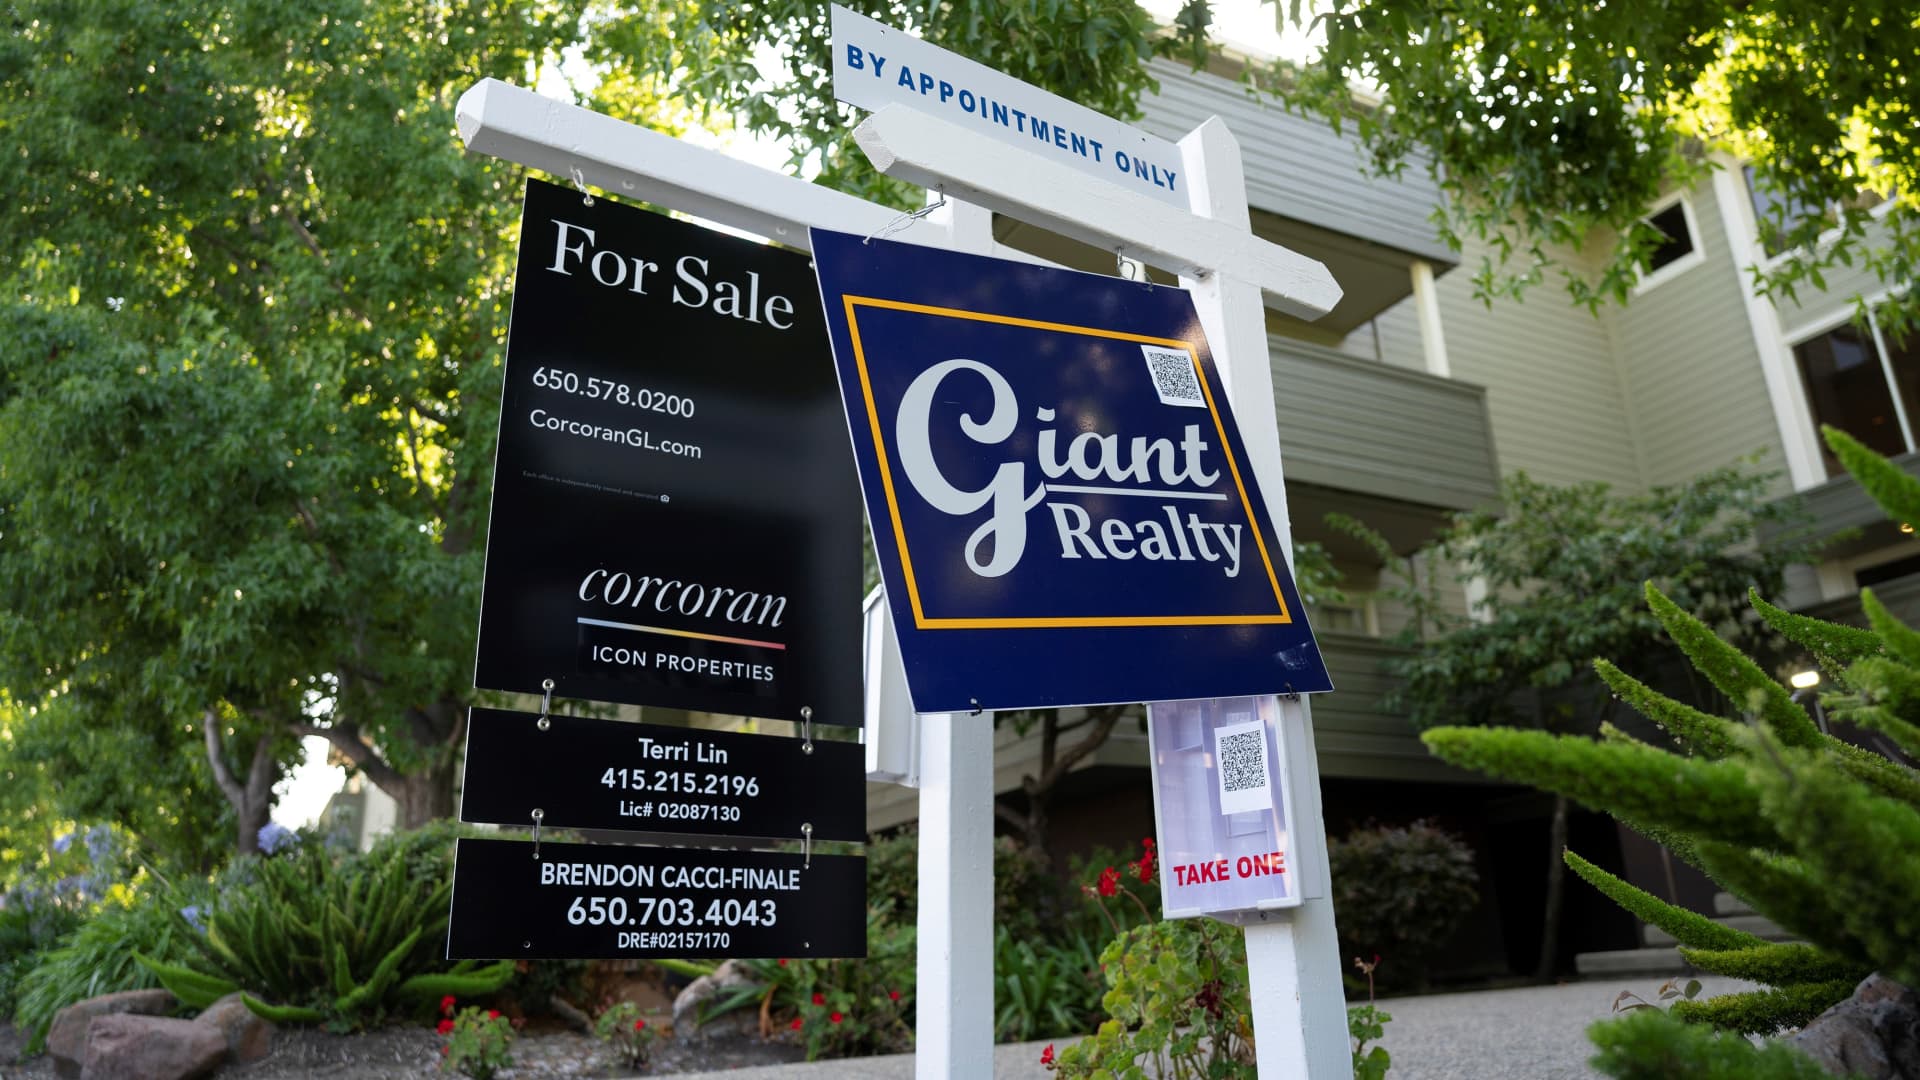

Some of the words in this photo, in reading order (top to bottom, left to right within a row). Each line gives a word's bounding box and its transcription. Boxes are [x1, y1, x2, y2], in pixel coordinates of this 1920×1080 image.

[847, 44, 886, 77] BY
[898, 66, 1102, 161] APPOINTMENT
[1115, 151, 1176, 191] ONLY
[546, 220, 658, 294] For
[673, 256, 793, 329] Sale
[533, 367, 694, 418] 650.578.0200
[530, 409, 701, 458] CorcoranGL.com
[896, 359, 1220, 578] Giant
[1047, 503, 1242, 577] Realty
[579, 569, 786, 627] corcoran
[593, 646, 646, 666] ICON
[656, 654, 773, 681] PROPERTIES
[639, 738, 688, 760] Terri
[698, 743, 727, 763] Lin
[601, 768, 759, 796] 415.215.2196
[620, 801, 653, 816] Lic#
[659, 803, 740, 821] 02087130
[542, 863, 653, 887] BRENDON
[661, 866, 800, 890] CACCI-FINALE
[1173, 859, 1230, 886] TAKE
[1236, 852, 1286, 878] ONE
[568, 897, 776, 926] 650.703.4043
[618, 932, 729, 948] DRE#02157170
